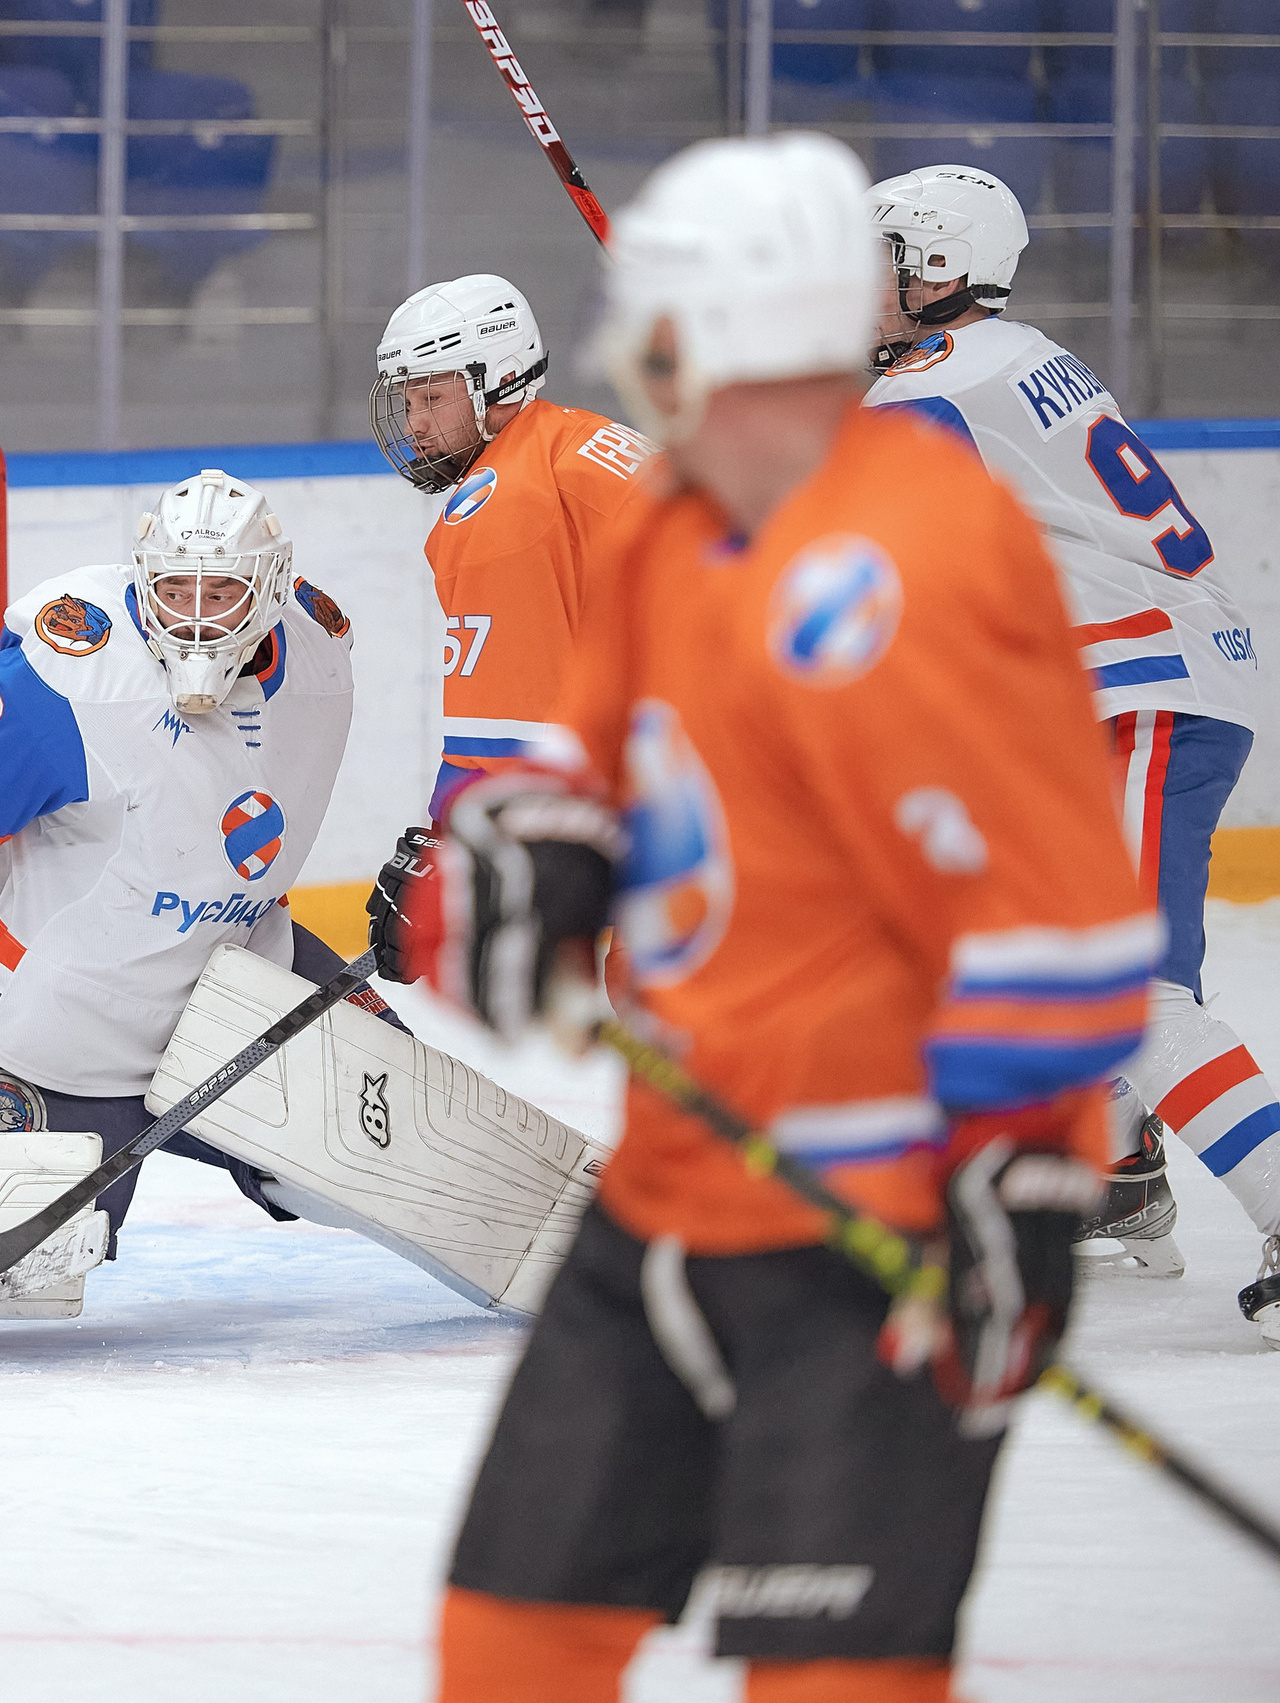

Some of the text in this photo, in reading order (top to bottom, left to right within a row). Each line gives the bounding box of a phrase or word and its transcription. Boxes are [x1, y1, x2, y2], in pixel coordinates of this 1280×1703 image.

[480, 320, 517, 335] BAUER
[498, 377, 526, 397] BAUER
[1085, 412, 1215, 578] 9
[194, 529, 226, 538] ALROSA
